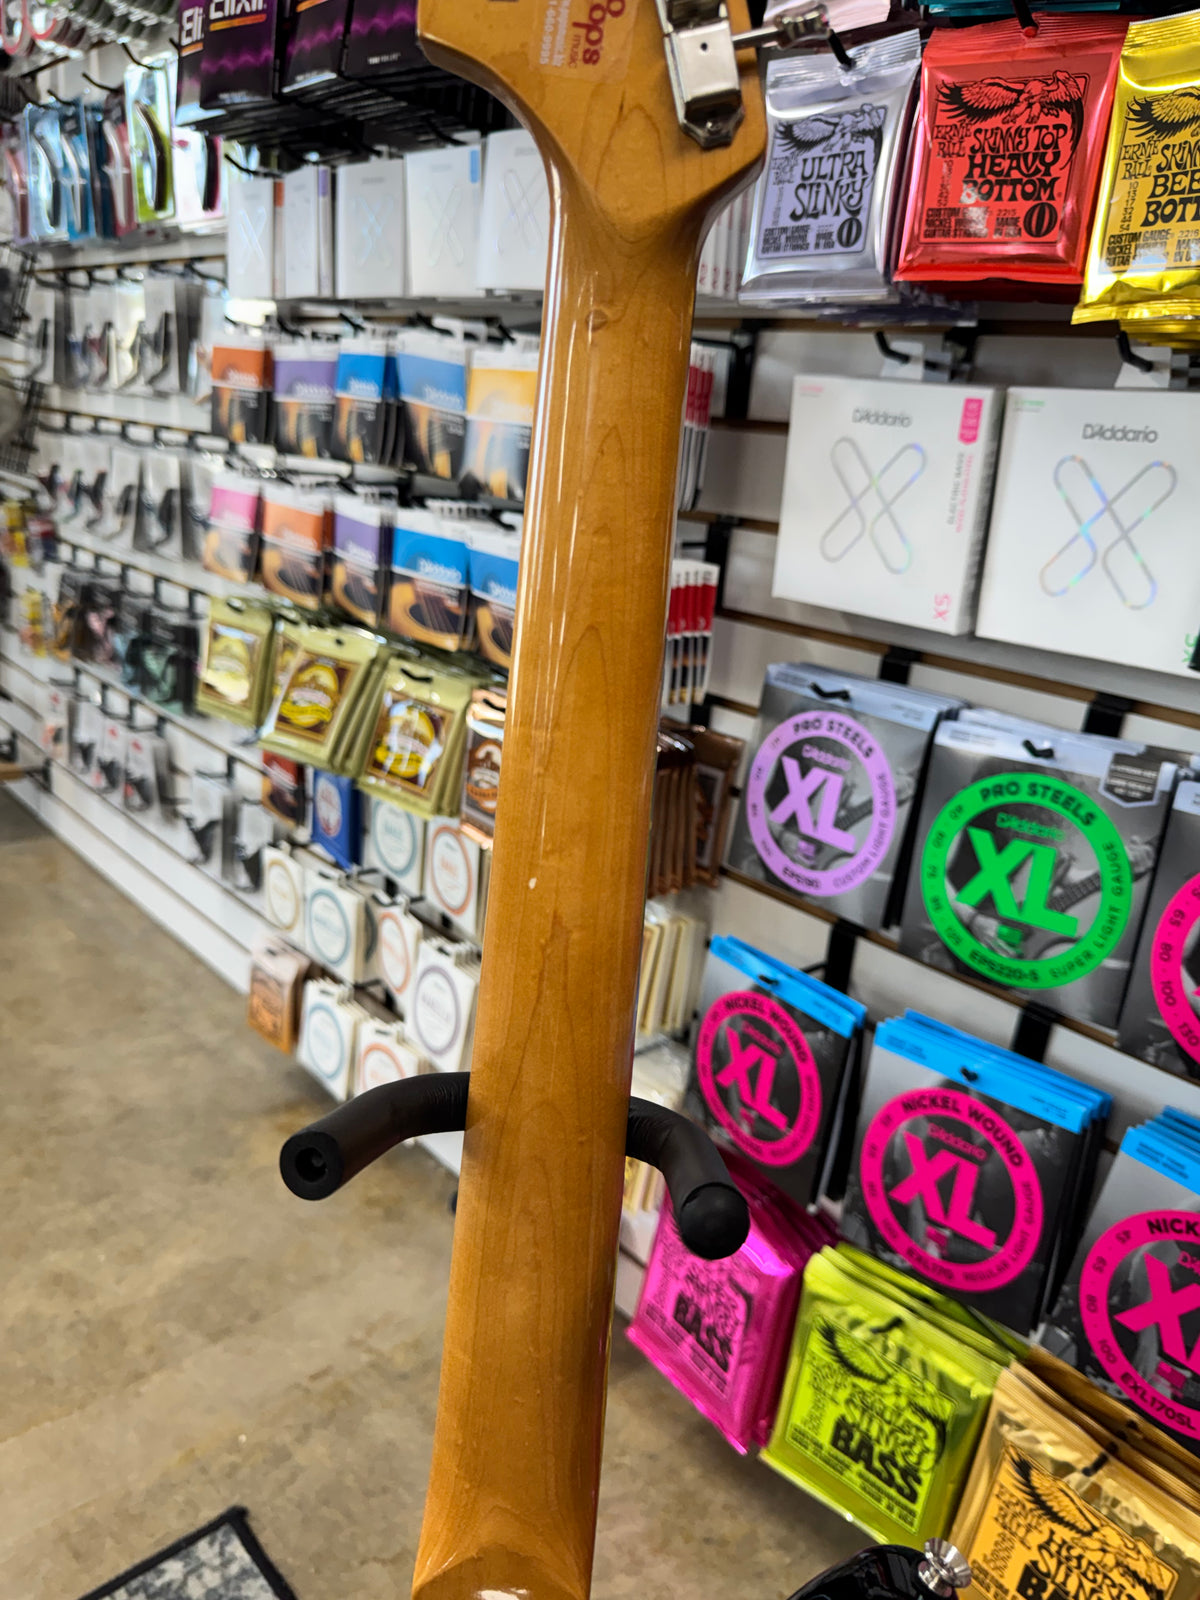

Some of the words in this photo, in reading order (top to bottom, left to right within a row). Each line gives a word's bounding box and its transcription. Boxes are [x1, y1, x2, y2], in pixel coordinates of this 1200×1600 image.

[181, 7, 204, 46] Eli
[934, 120, 972, 140] ERNIE
[970, 126, 1031, 154] SKINNY
[1034, 123, 1068, 150] TOP
[1121, 135, 1161, 160] ERNIE
[800, 151, 868, 181] ULTRA
[964, 150, 1061, 178] HEAVY
[1122, 158, 1152, 180] BALL
[790, 176, 869, 221] SLINKY
[959, 177, 1061, 204] BOTTOM
[1108, 232, 1142, 245] CUSTOM
[1082, 424, 1158, 443] D'Addario
[793, 718, 823, 734] PRO
[827, 719, 875, 758] STEELS
[769, 755, 856, 853] XL
[980, 781, 1021, 802] PRO
[1028, 782, 1097, 828] STEELS
[955, 826, 1078, 937] XL
[1103, 841, 1124, 897] GAUGE
[1093, 905, 1121, 949] LIGHT
[1169, 908, 1185, 928] 65
[1050, 949, 1094, 978] SUPER
[1159, 942, 1173, 962] 80
[1160, 979, 1177, 1007] 100
[1178, 1021, 1200, 1047] 130
[715, 1025, 788, 1131] XL
[902, 1095, 962, 1114] NICKEL
[967, 1105, 1024, 1167] WOUND
[889, 1130, 997, 1249] XL
[1098, 1339, 1117, 1365] 100
[1120, 1371, 1197, 1431] EXL170SL
[829, 1414, 923, 1504] BASS
